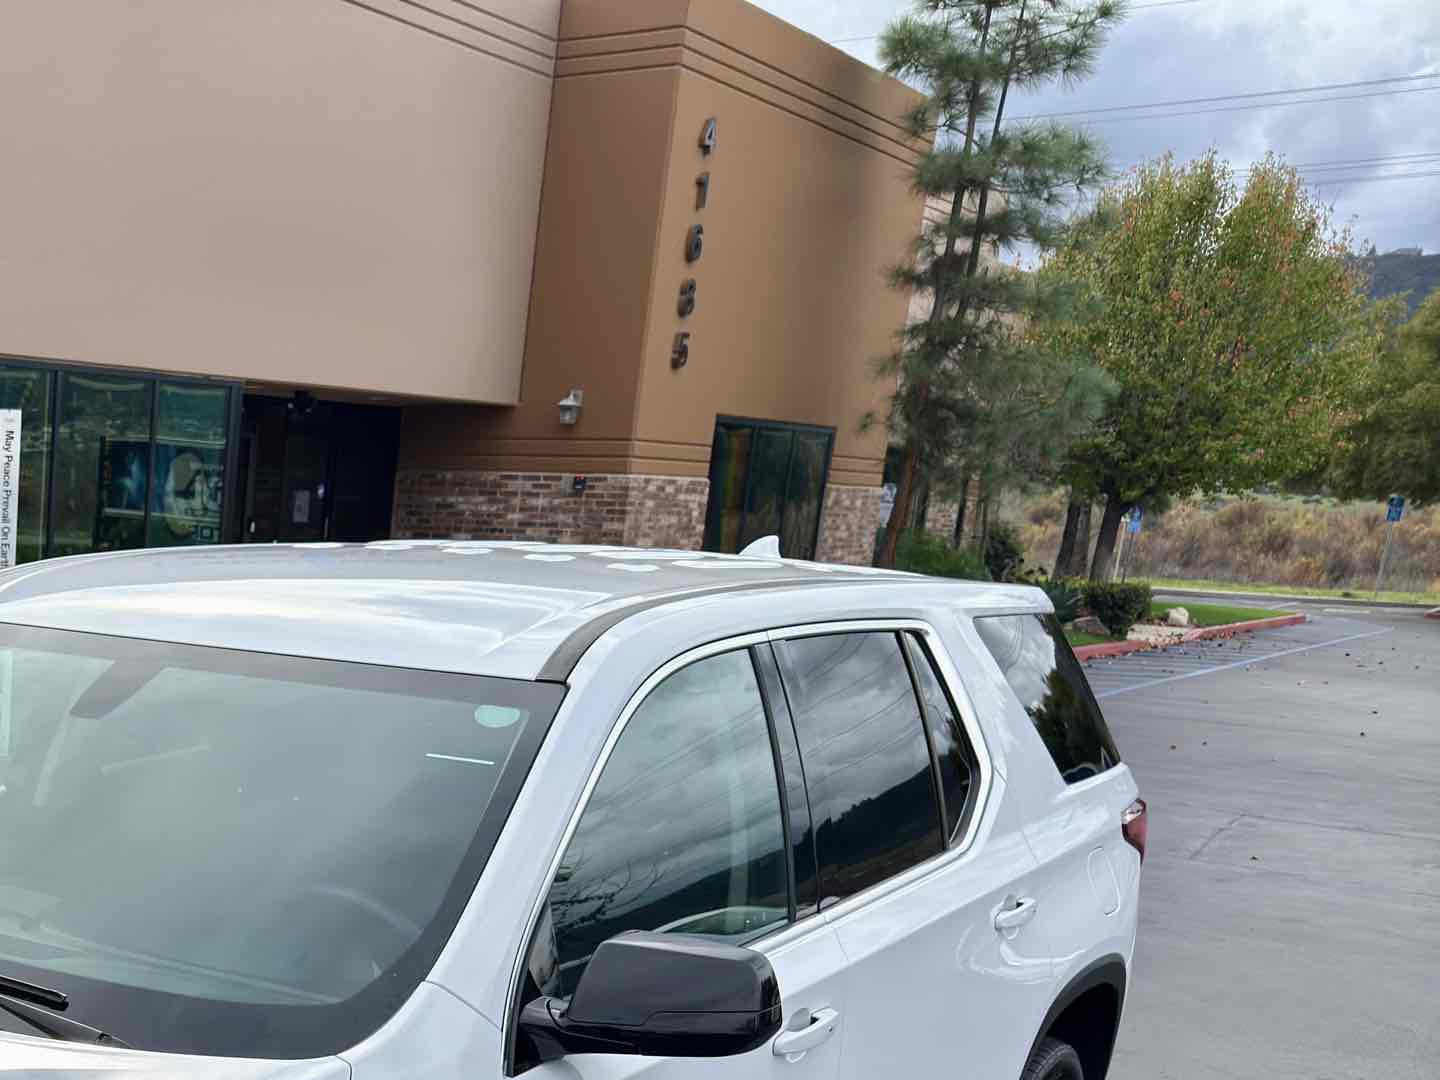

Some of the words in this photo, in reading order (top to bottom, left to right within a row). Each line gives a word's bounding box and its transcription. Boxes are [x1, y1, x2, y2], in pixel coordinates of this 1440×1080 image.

[2, 430, 15, 452] May
[2, 455, 14, 487] Peace
[1, 489, 13, 524] Prevail
[0, 526, 11, 541] On
